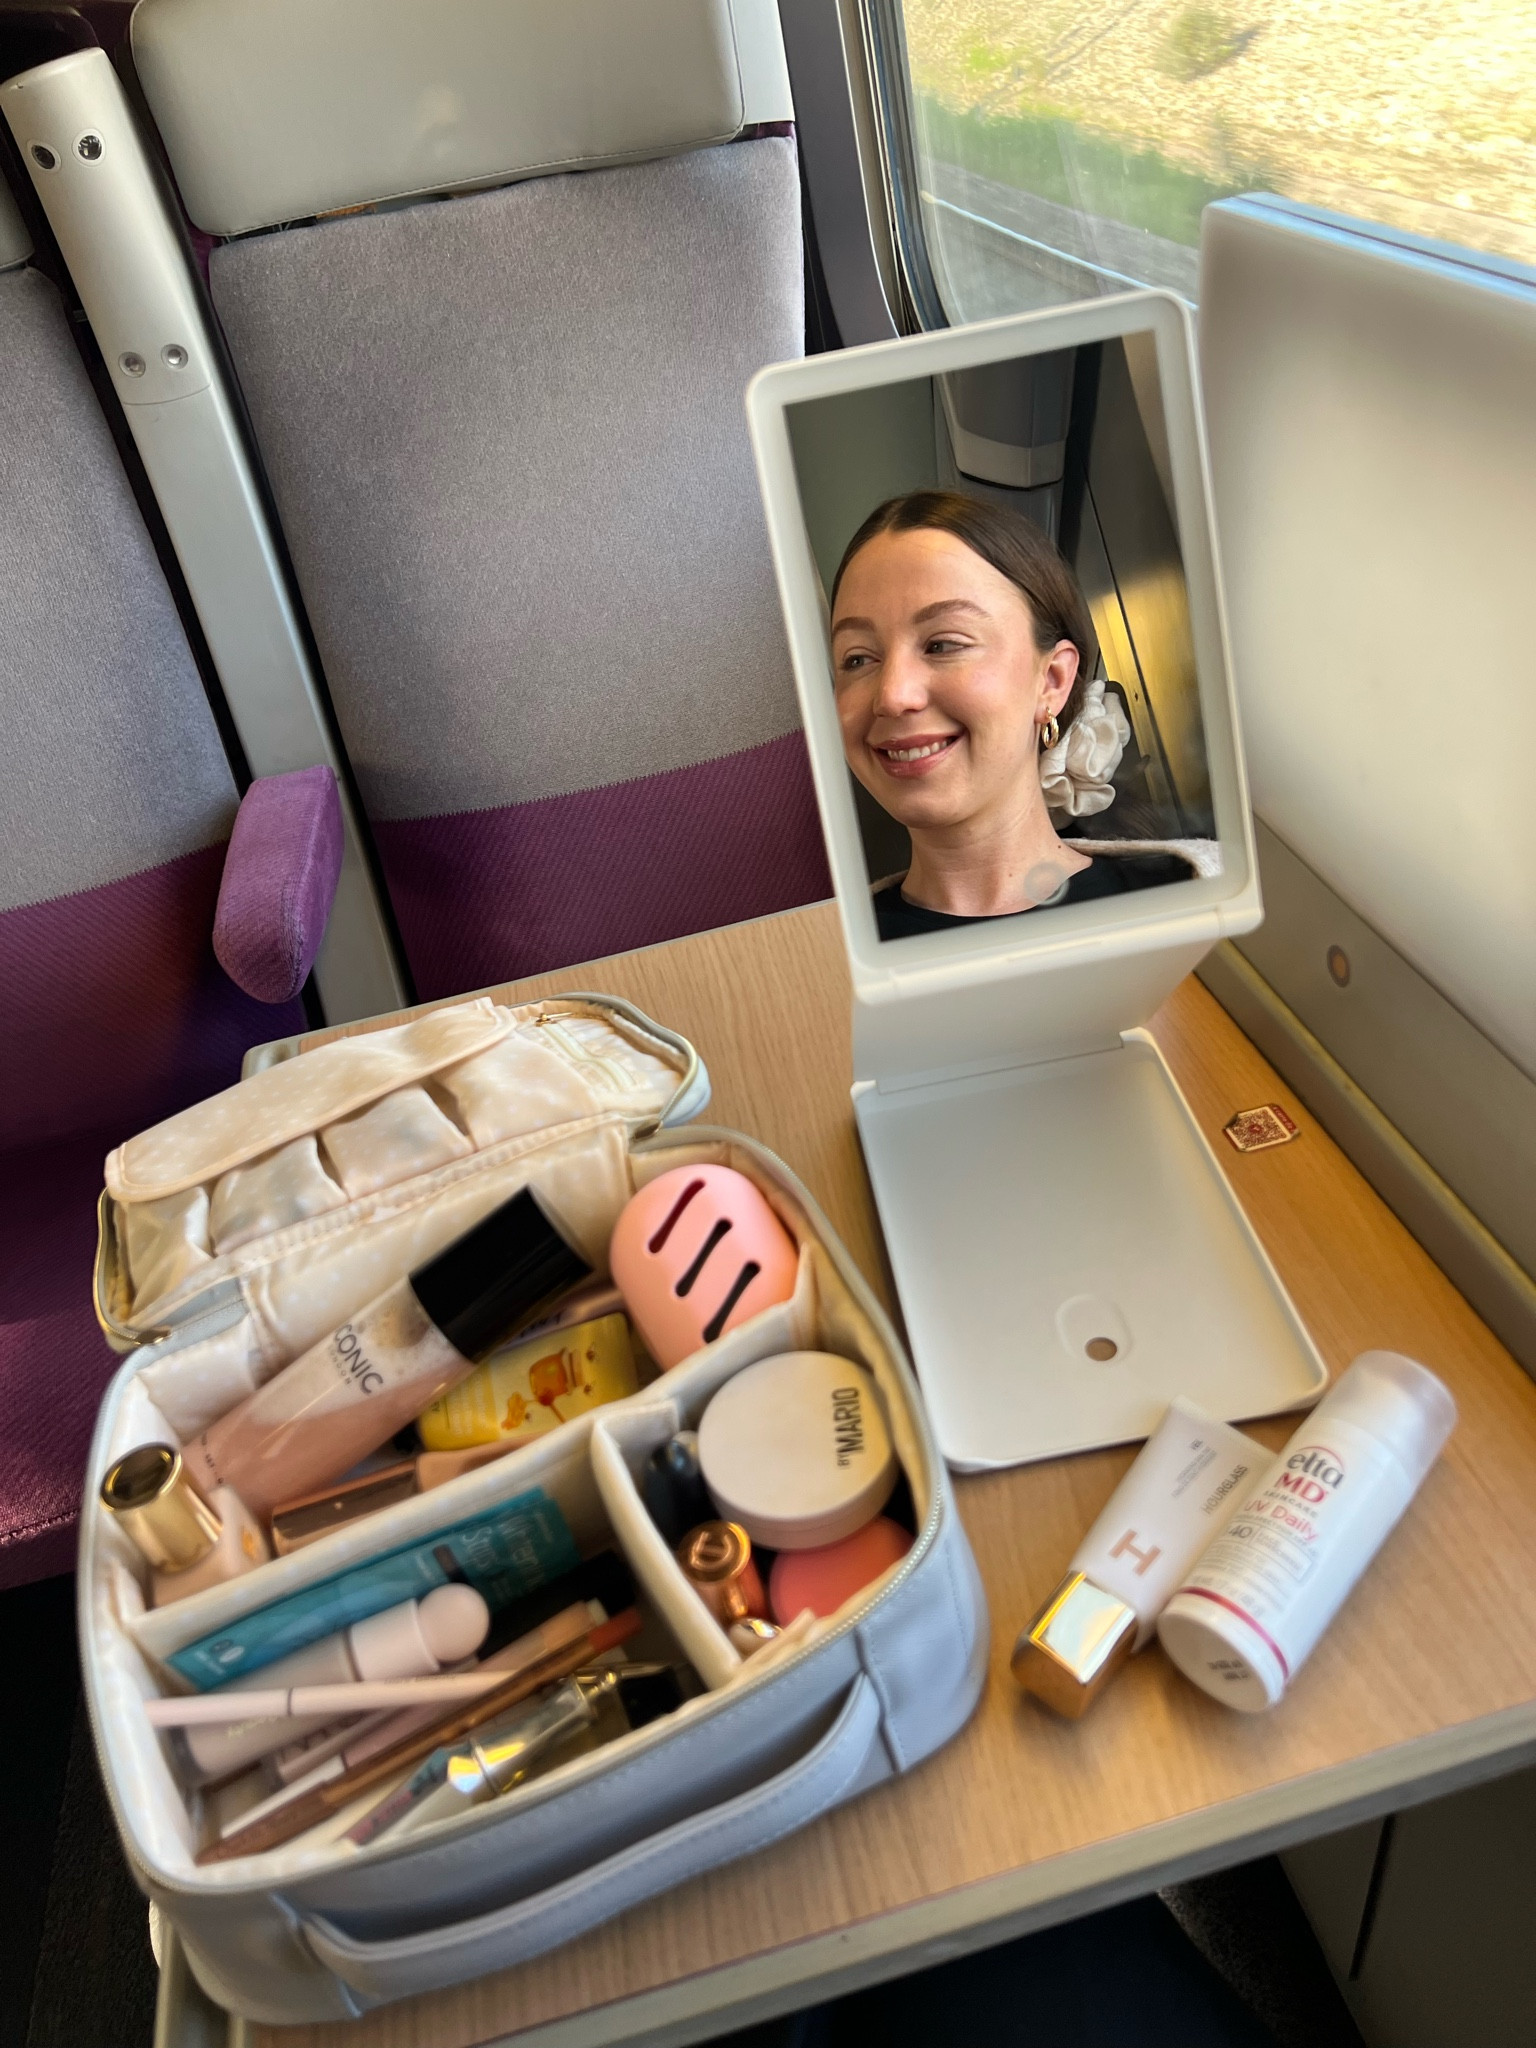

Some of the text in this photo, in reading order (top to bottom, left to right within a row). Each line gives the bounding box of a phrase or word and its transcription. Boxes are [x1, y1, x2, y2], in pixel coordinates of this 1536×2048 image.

[335, 1323, 384, 1394] CONIC
[832, 1387, 864, 1453] MARIO
[1202, 1464, 1248, 1514] HOURGLASS
[1274, 1472, 1325, 1503] MD
[1286, 1452, 1344, 1489] elta
[1270, 1505, 1318, 1543] Daily
[1109, 1529, 1161, 1576] H
